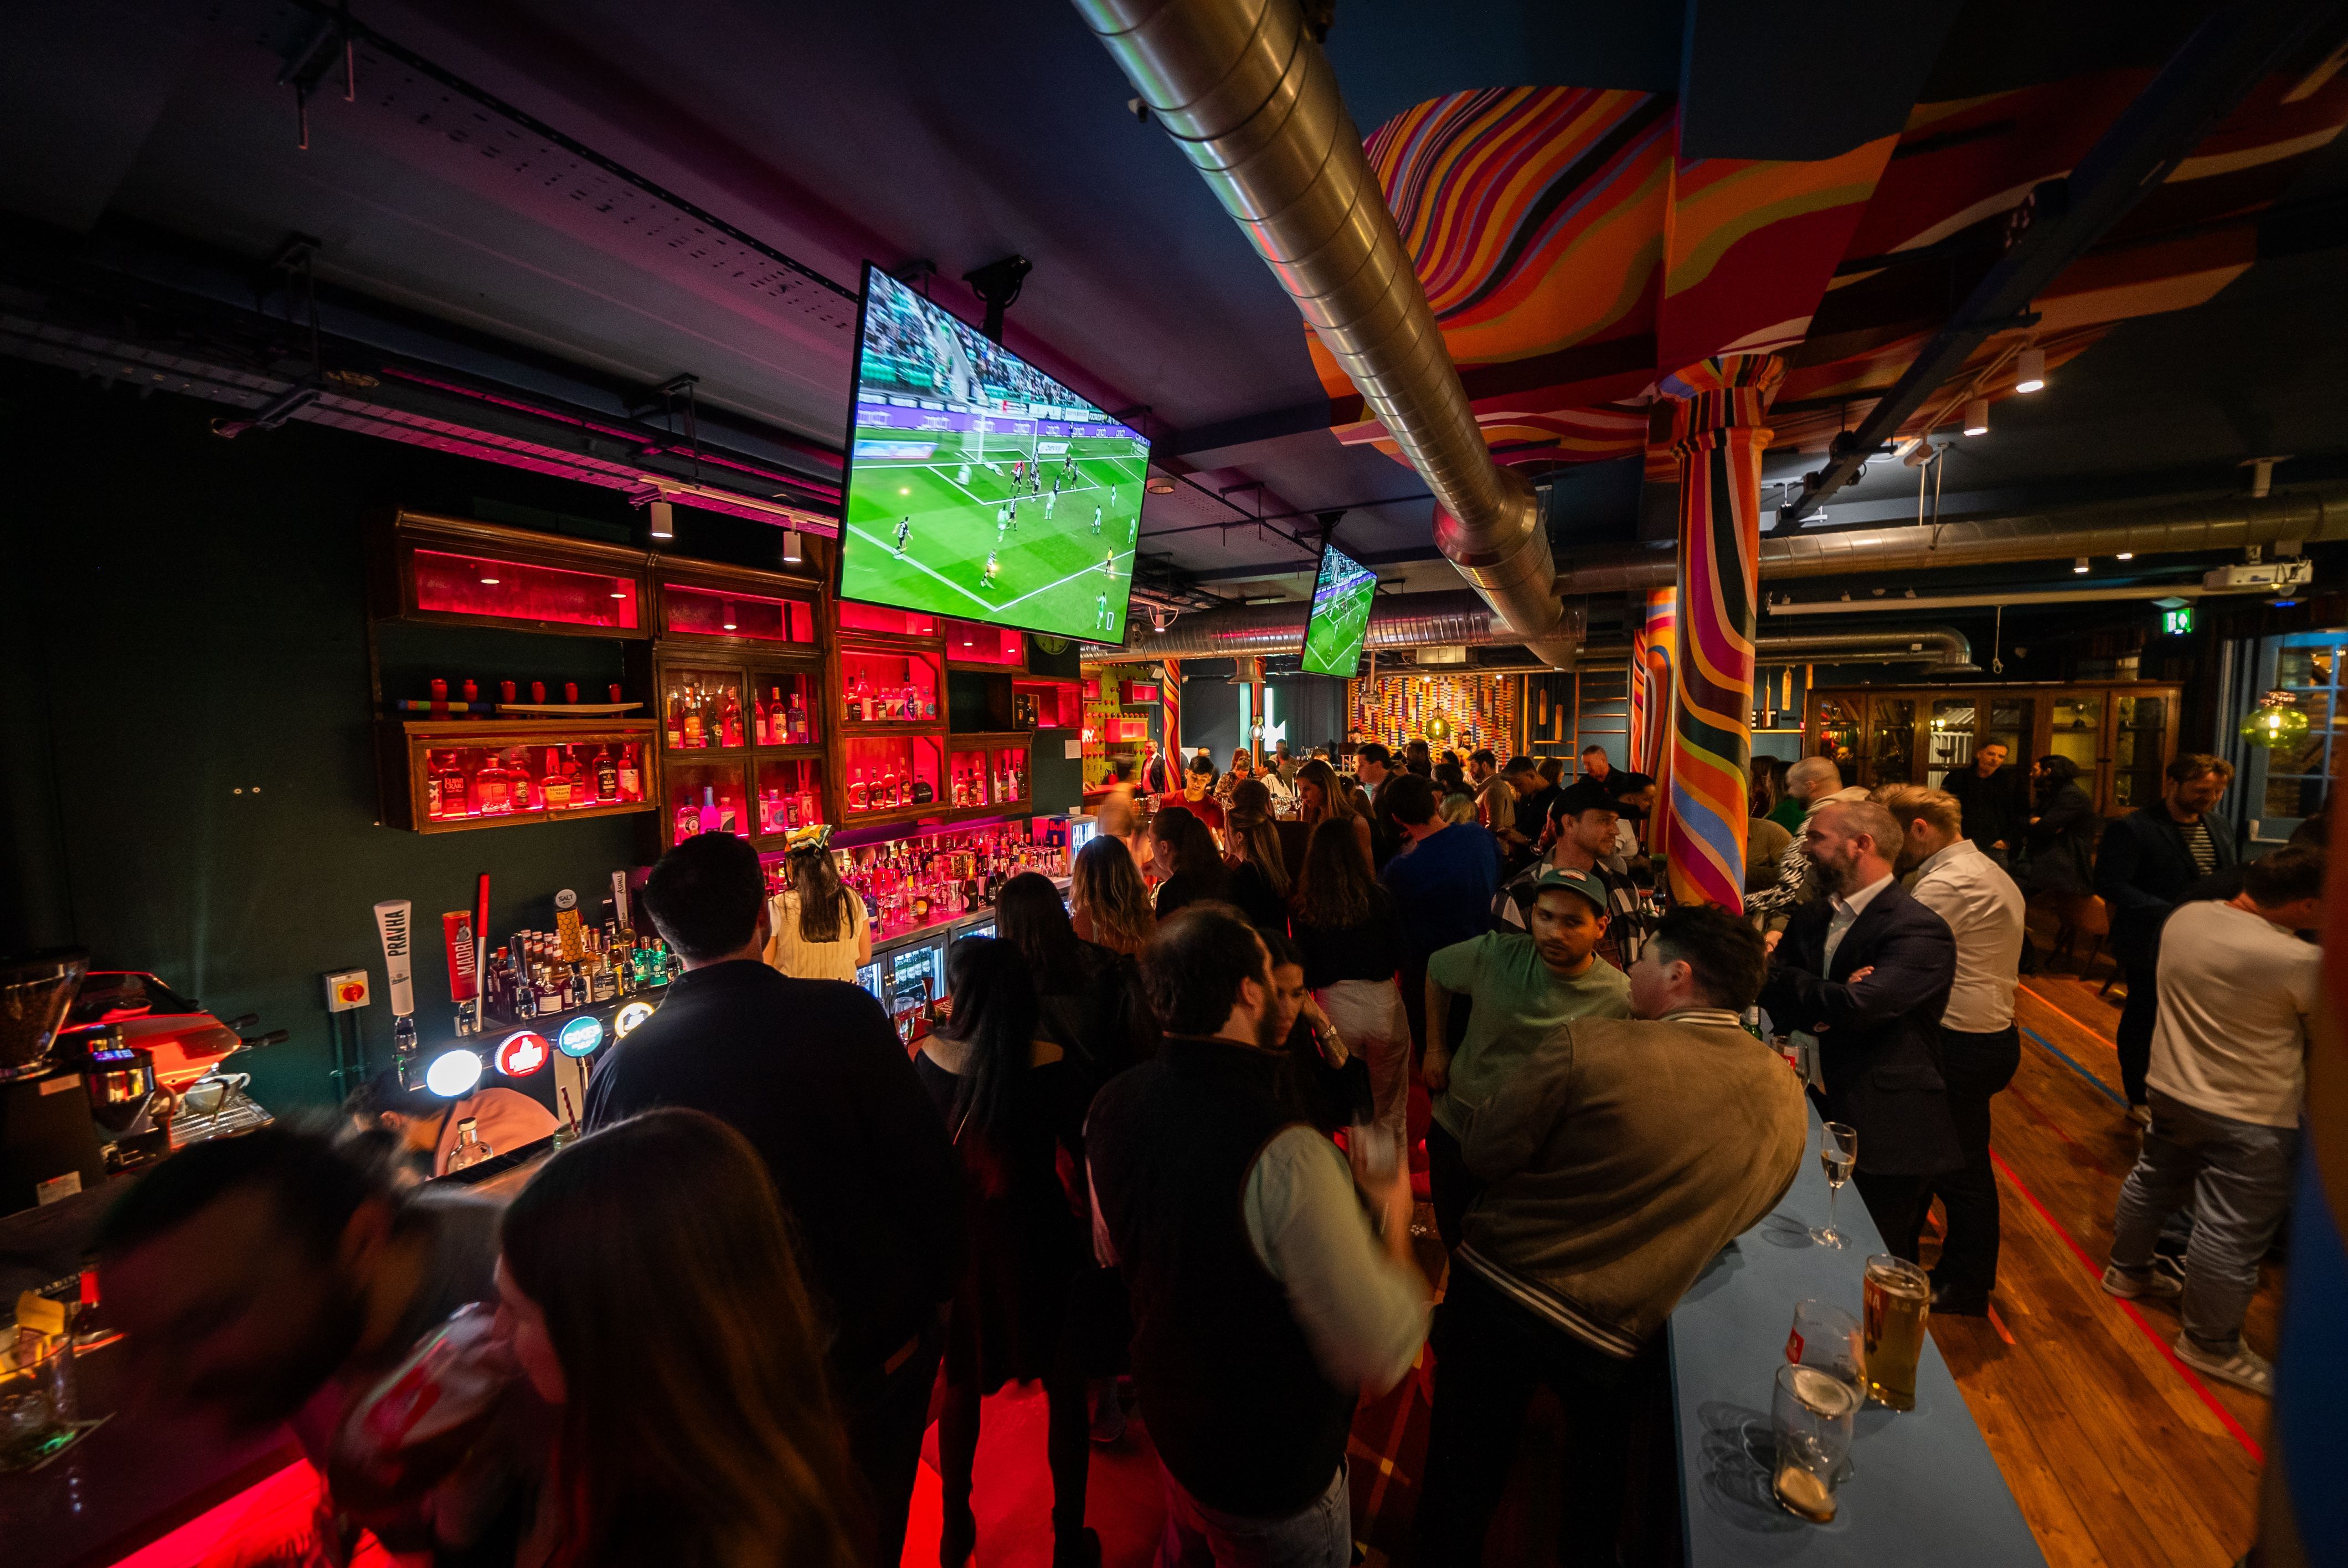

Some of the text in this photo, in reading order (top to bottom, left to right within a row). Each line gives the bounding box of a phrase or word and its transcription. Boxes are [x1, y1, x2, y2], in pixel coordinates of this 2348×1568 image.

[1049, 821, 1065, 832] Bull
[558, 894, 573, 902] SALT
[384, 909, 408, 957] PRAVHA
